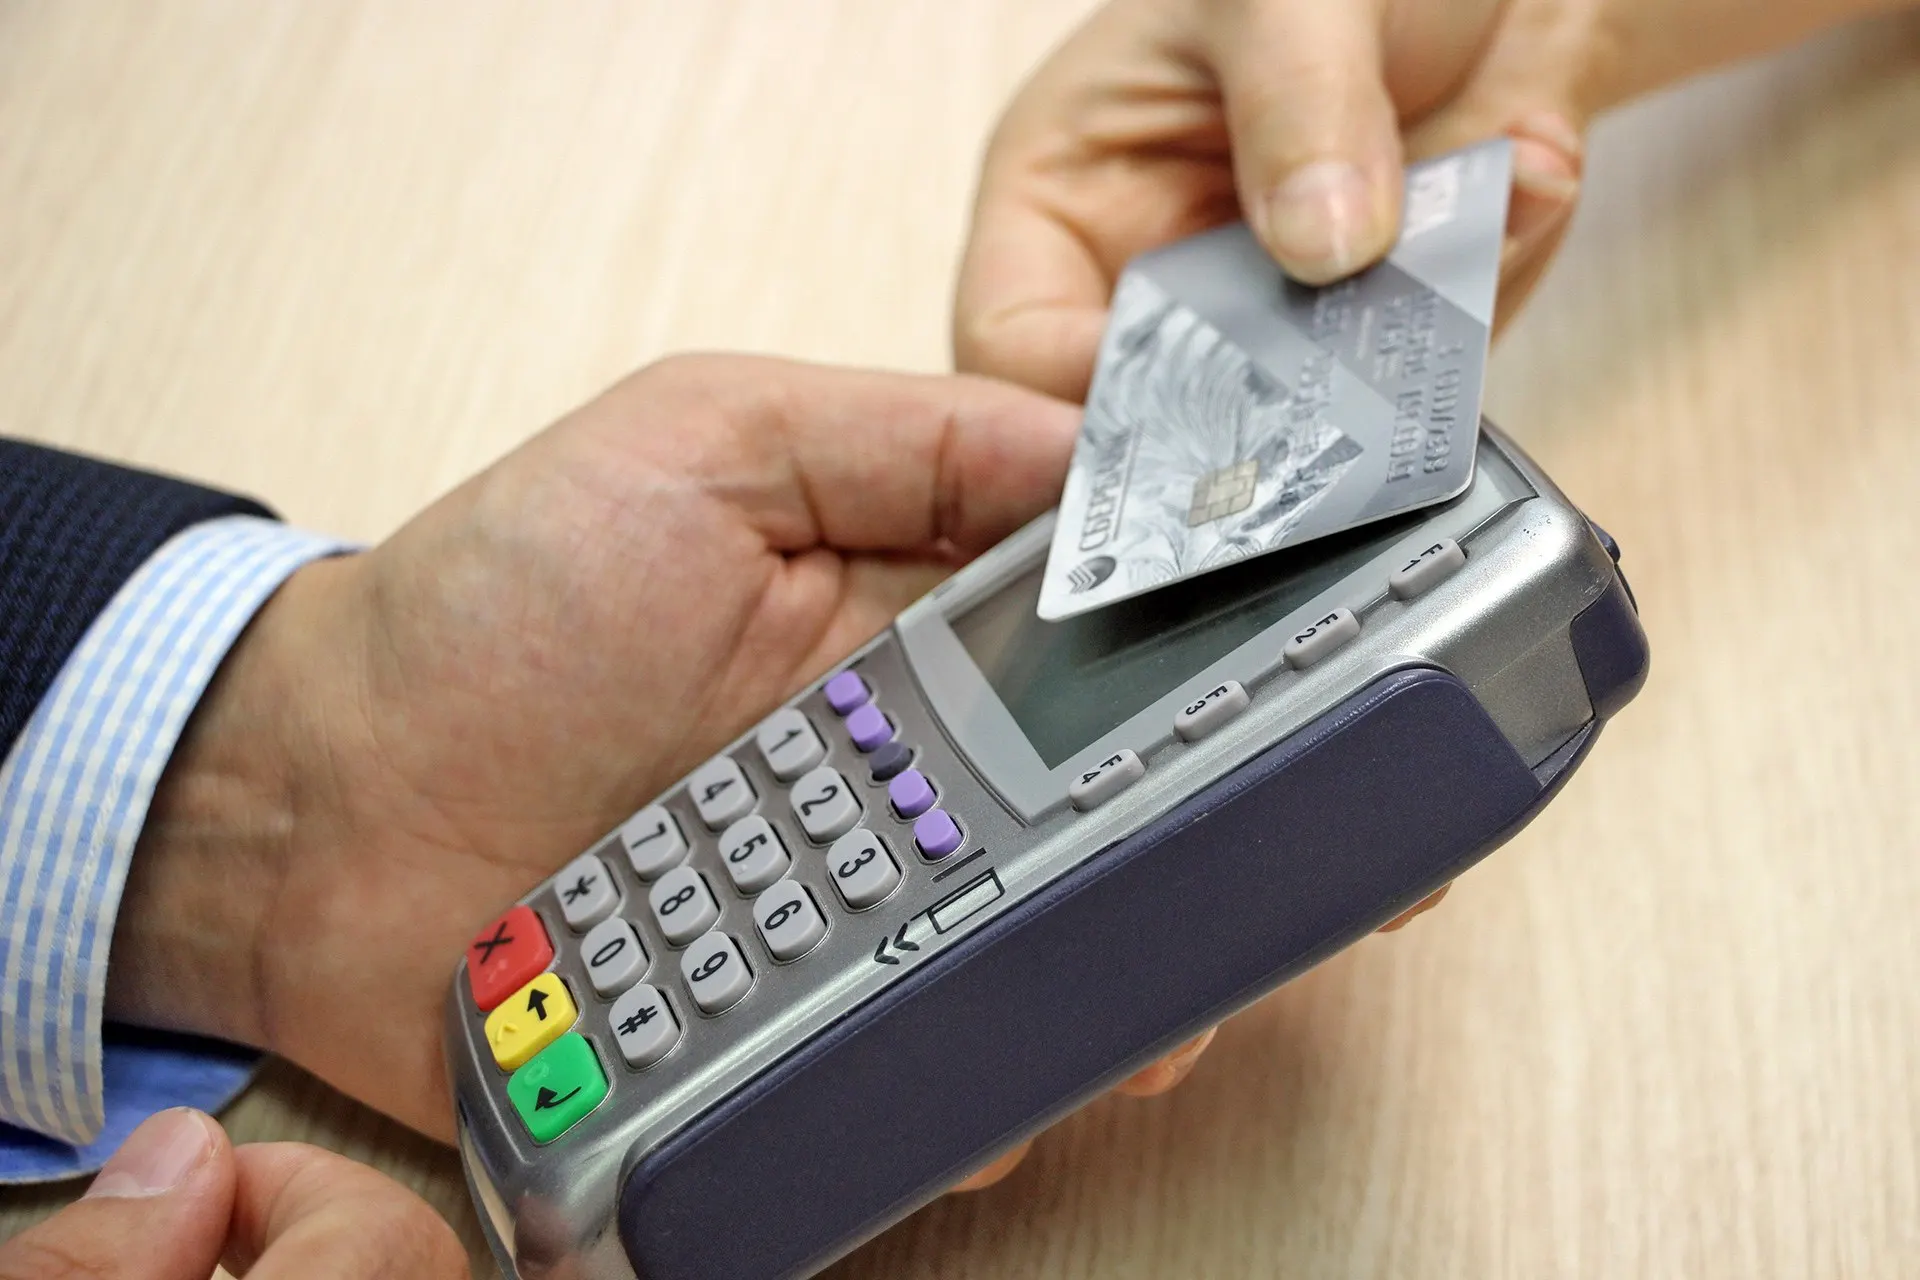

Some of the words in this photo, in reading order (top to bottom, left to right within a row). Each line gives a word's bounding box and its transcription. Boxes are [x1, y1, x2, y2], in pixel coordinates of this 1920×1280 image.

[1402, 544, 1443, 572] F1
[1296, 614, 1338, 644] F2
[1186, 686, 1228, 715] F3
[1082, 755, 1123, 784] F4
[769, 729, 803, 754] 1
[799, 786, 838, 817] 2
[838, 848, 877, 879] 3
[702, 779, 735, 804] 4
[729, 833, 768, 864] 5
[764, 900, 802, 931] 6
[631, 822, 666, 850] 7
[659, 886, 696, 916] 8
[690, 951, 729, 983] 9
[590, 938, 626, 968] 0
[617, 1005, 658, 1036] #
